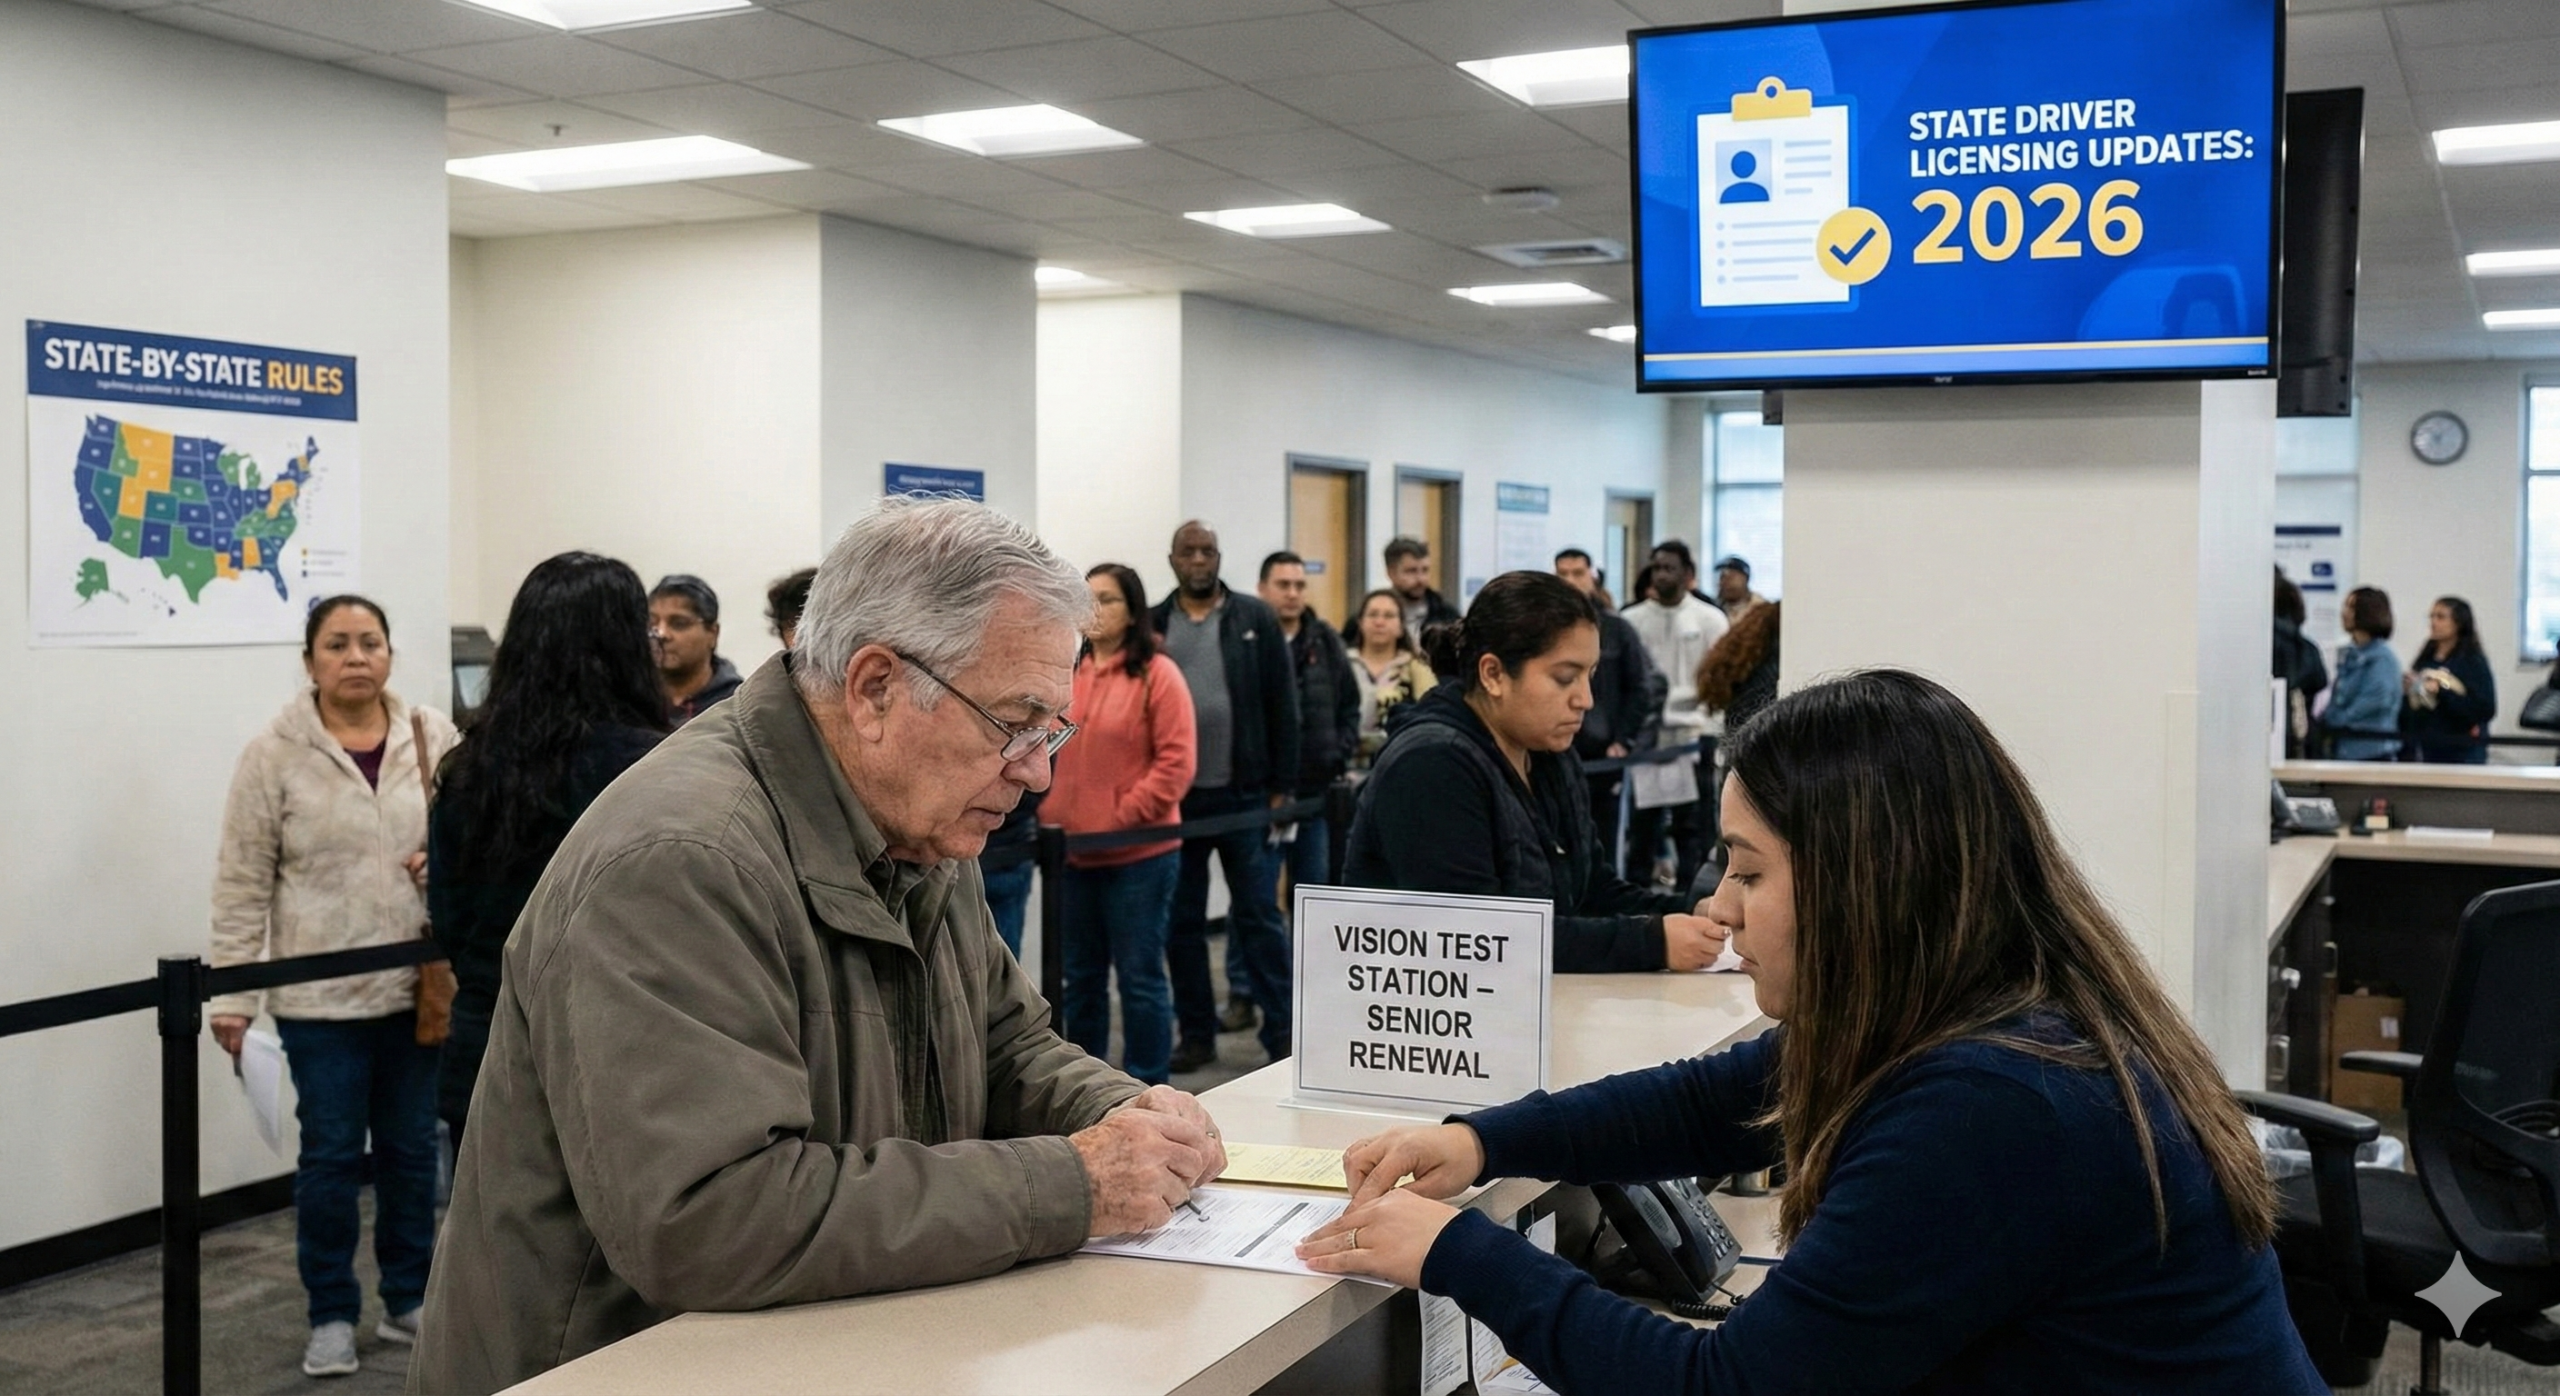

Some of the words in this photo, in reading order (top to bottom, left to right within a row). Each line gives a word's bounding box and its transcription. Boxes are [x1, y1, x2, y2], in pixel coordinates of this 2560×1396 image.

[1909, 106, 2006, 141] STATE
[2015, 98, 2136, 135] DRIVER
[1910, 139, 2079, 178] LICENSING
[2088, 129, 2254, 168] UPDATES:
[1911, 179, 2144, 264] 2026
[45, 337, 262, 388] STATE-BY-STATE
[267, 360, 344, 395] RULES
[1334, 925, 1427, 957] VISION
[1436, 932, 1509, 963] TEST
[1348, 964, 1468, 999] STATION
[1367, 1004, 1473, 1039] SENIOR
[1350, 1040, 1490, 1079] RENEWAL
